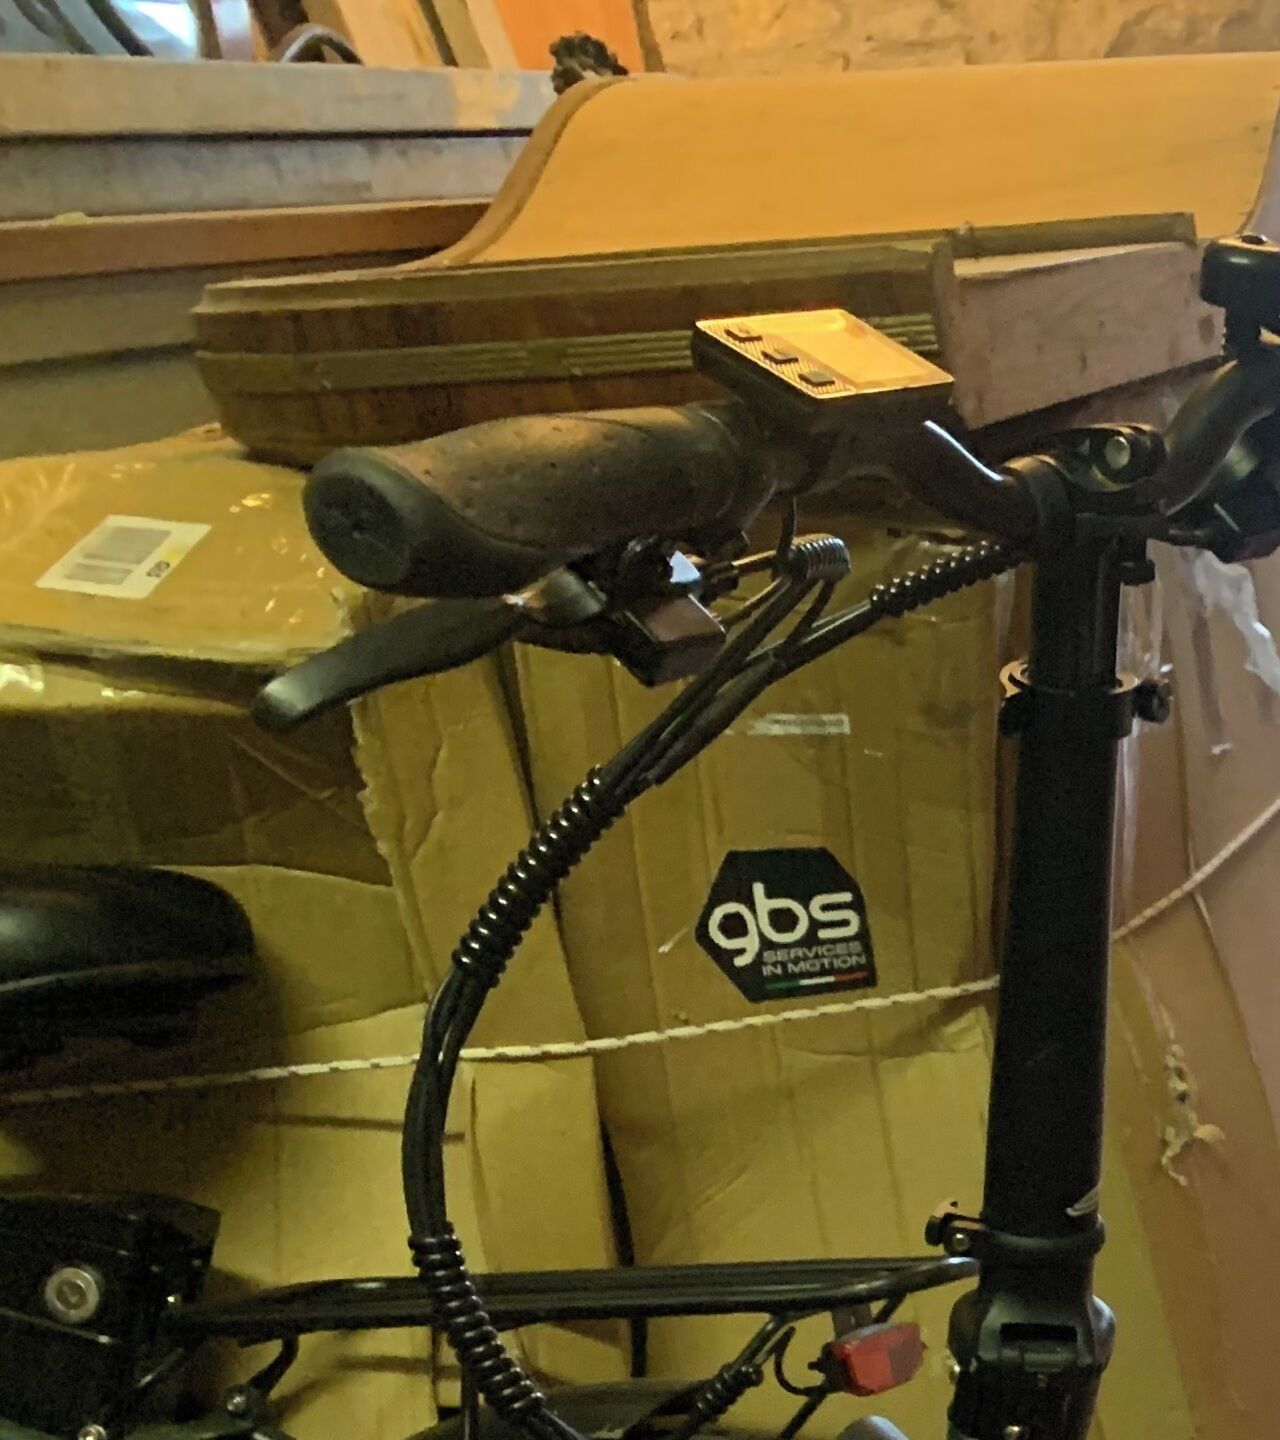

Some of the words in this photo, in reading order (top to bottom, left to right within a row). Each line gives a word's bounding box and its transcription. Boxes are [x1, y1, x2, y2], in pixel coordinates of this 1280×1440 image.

[708, 881, 861, 968] gbs
[762, 941, 863, 963] SERVICES
[762, 964, 782, 976] IN
[787, 954, 867, 974] MOTION
